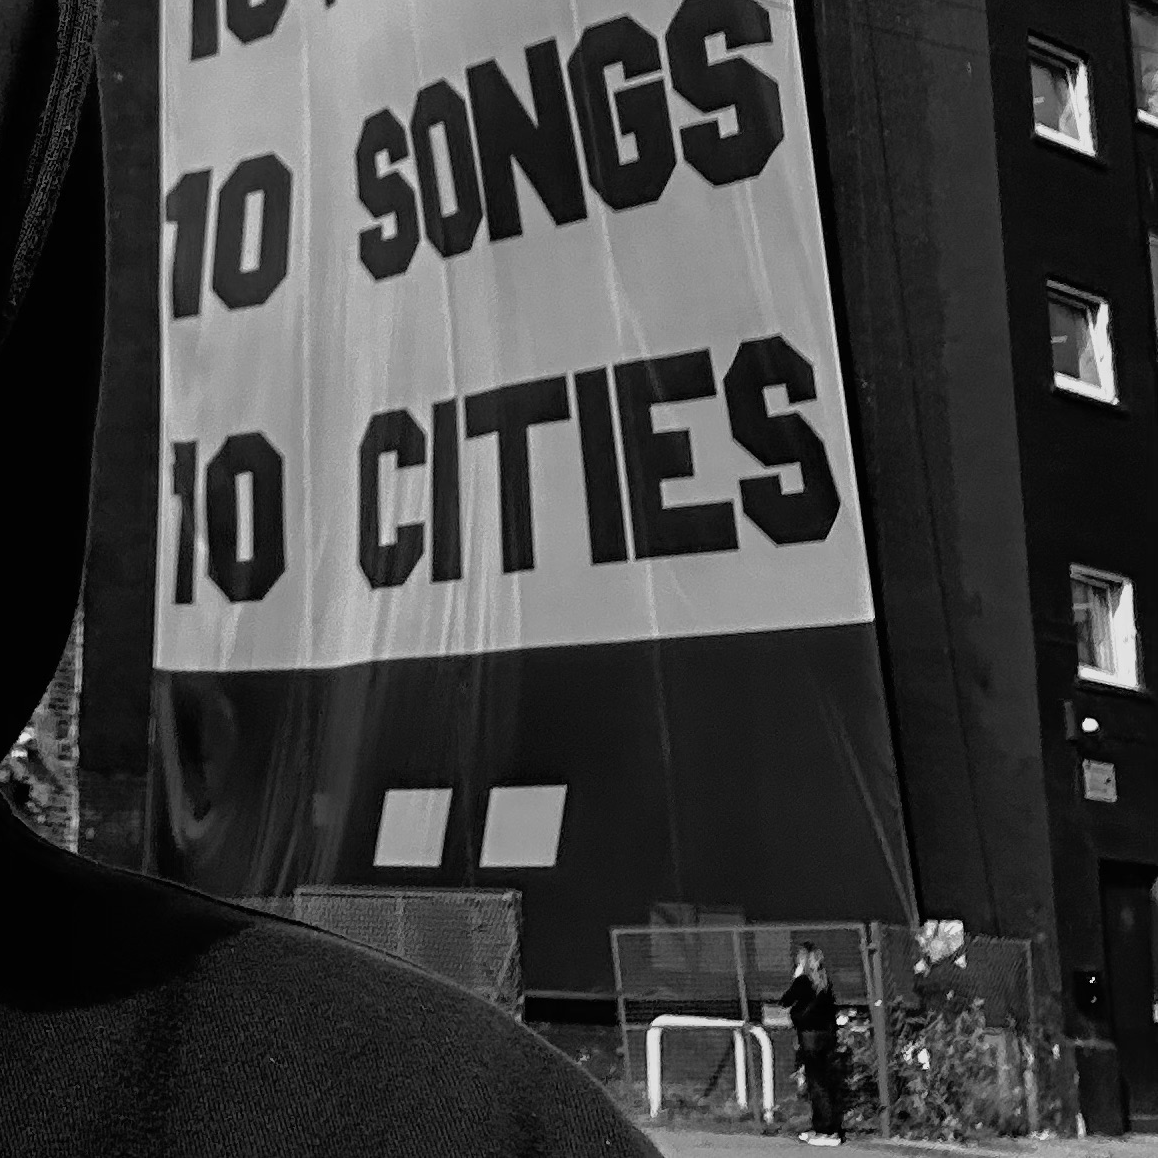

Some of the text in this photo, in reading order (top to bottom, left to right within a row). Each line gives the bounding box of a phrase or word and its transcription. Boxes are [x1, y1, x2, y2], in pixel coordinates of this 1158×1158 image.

[165, 153, 293, 320] 10
[172, 334, 841, 605] 10 CITIES
